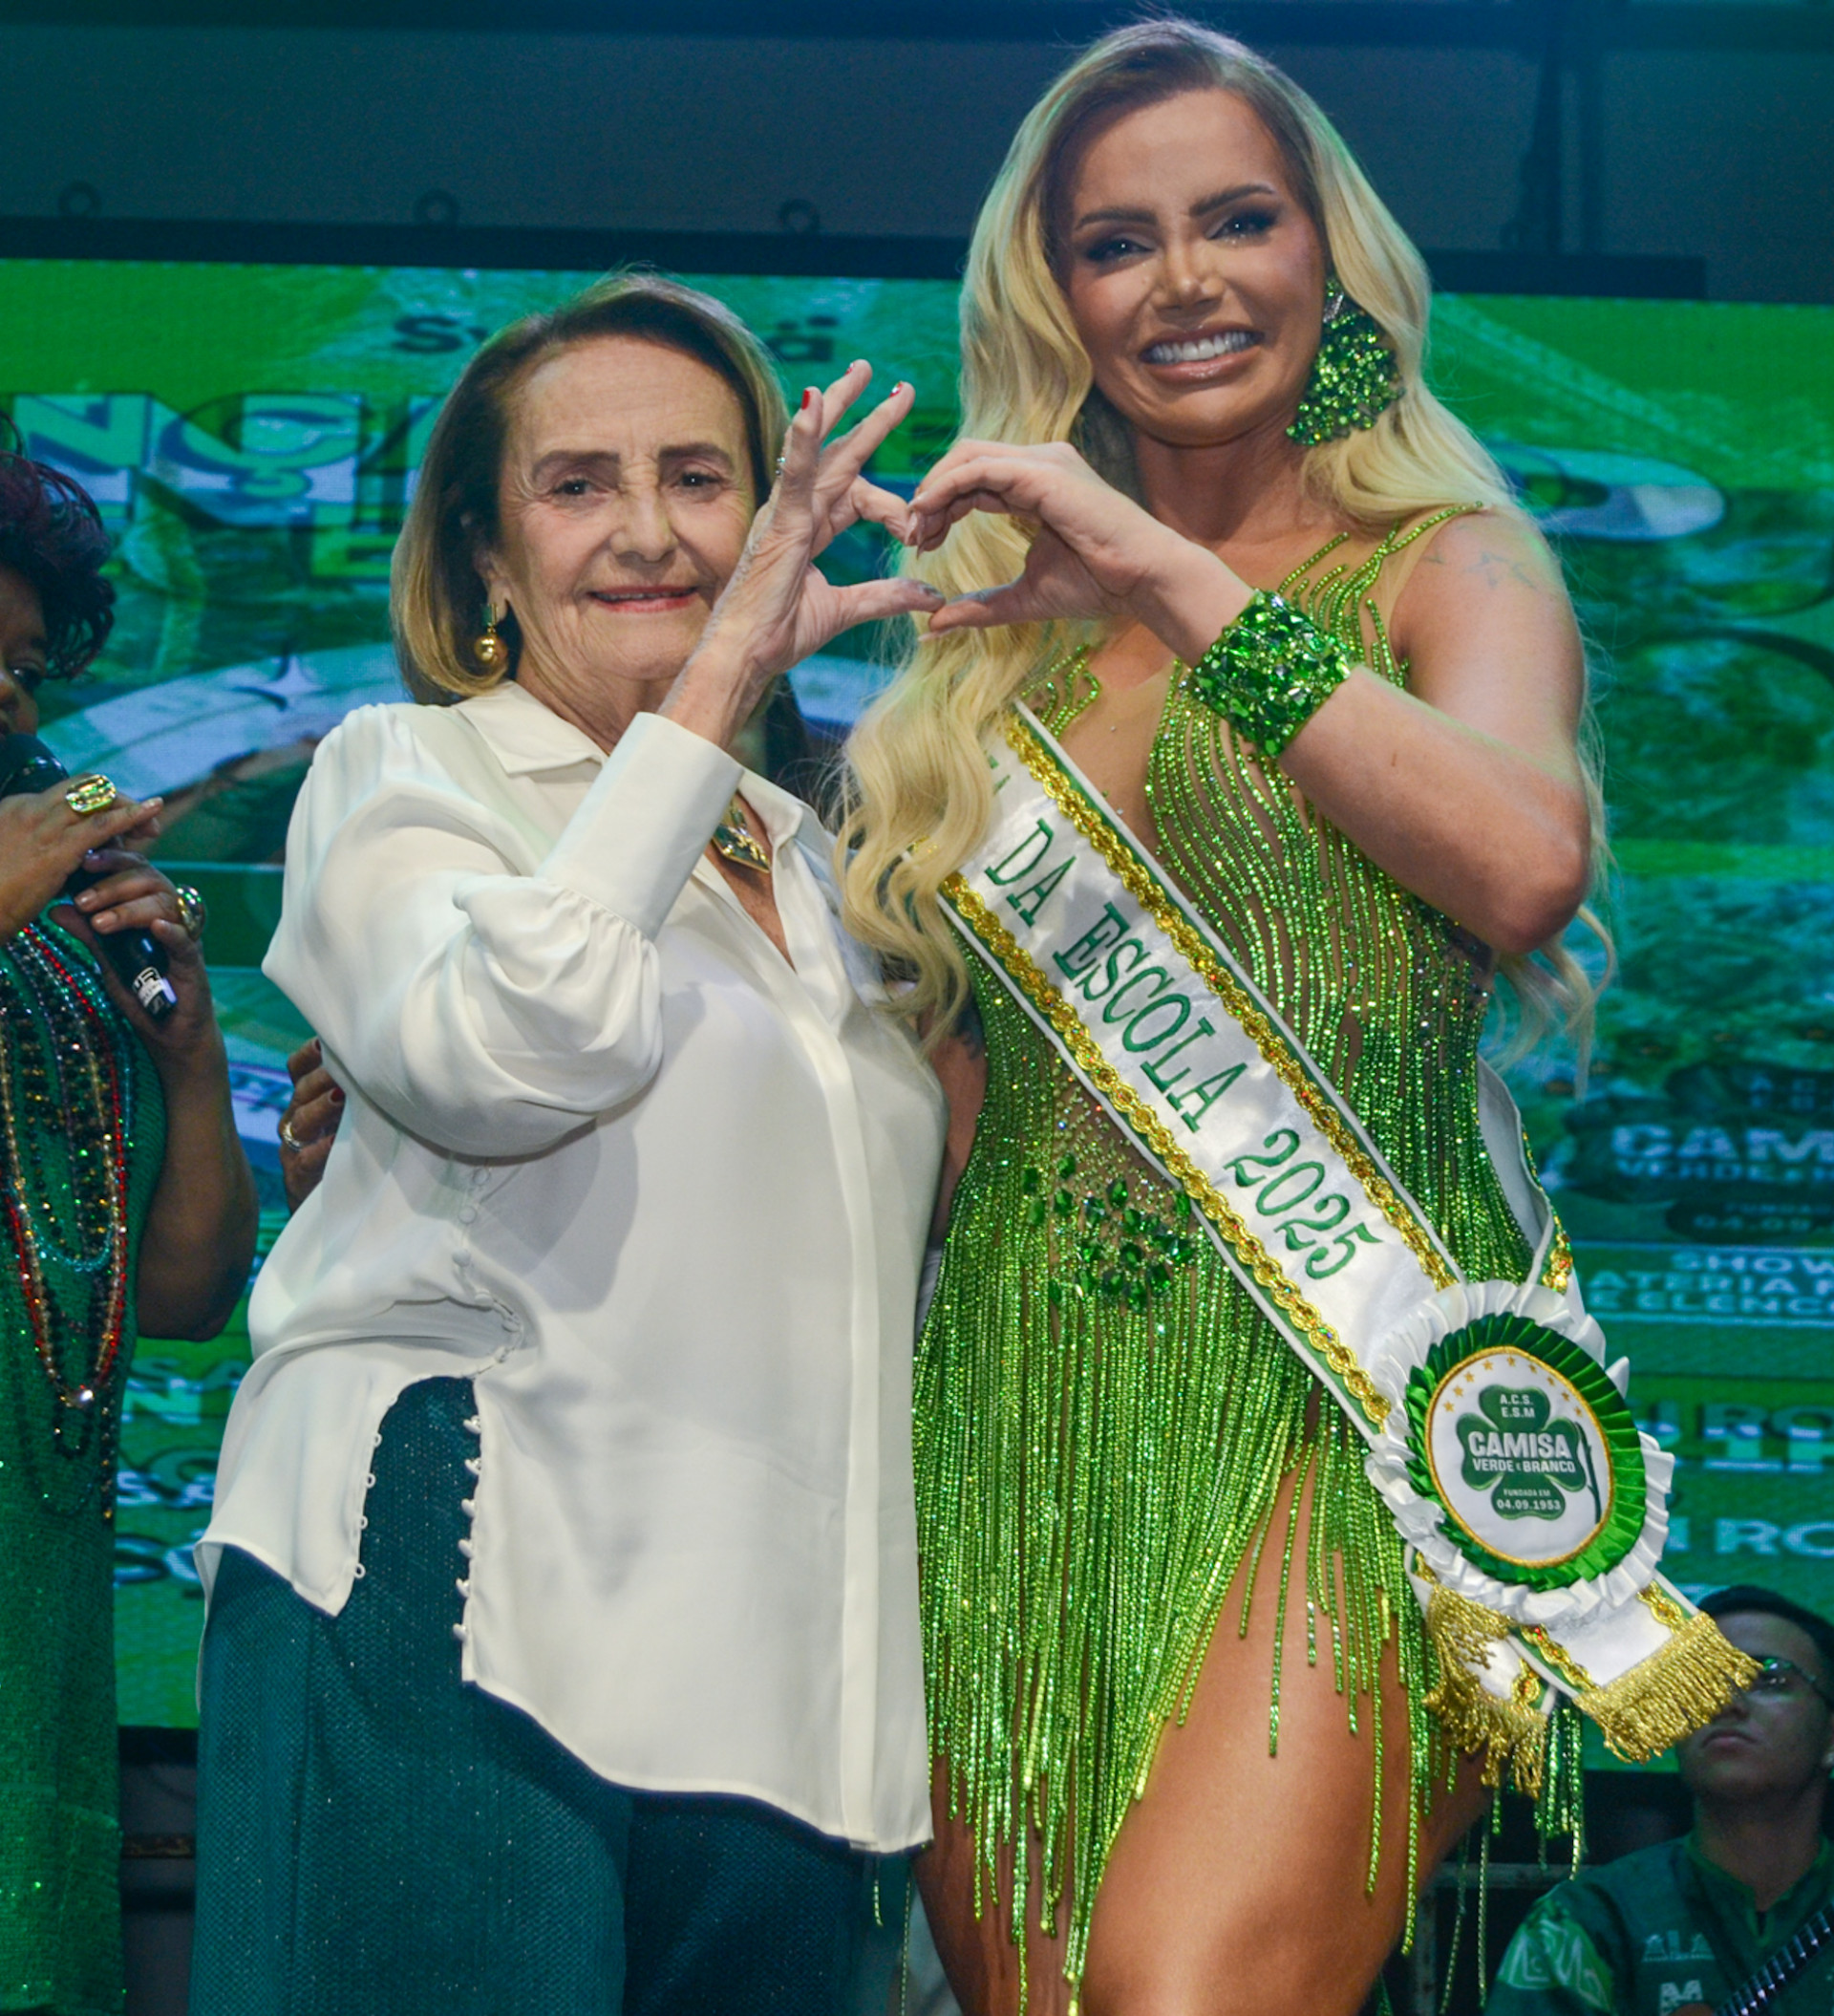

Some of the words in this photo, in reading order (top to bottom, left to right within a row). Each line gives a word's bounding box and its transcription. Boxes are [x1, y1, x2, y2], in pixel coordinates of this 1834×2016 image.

[985, 818, 1077, 927] DA
[1053, 901, 1249, 1134] ESCOLA
[1224, 1127, 1385, 1281] 2025
[1635, 1294, 1834, 1316] ELENC
[1467, 1430, 1573, 1460] CAMISA
[1472, 1458, 1515, 1472] VERDE
[1523, 1460, 1576, 1473] BRANCO
[1503, 1488, 1538, 1497] FUNDADA
[1496, 1498, 1562, 1511] 04.09.1953
